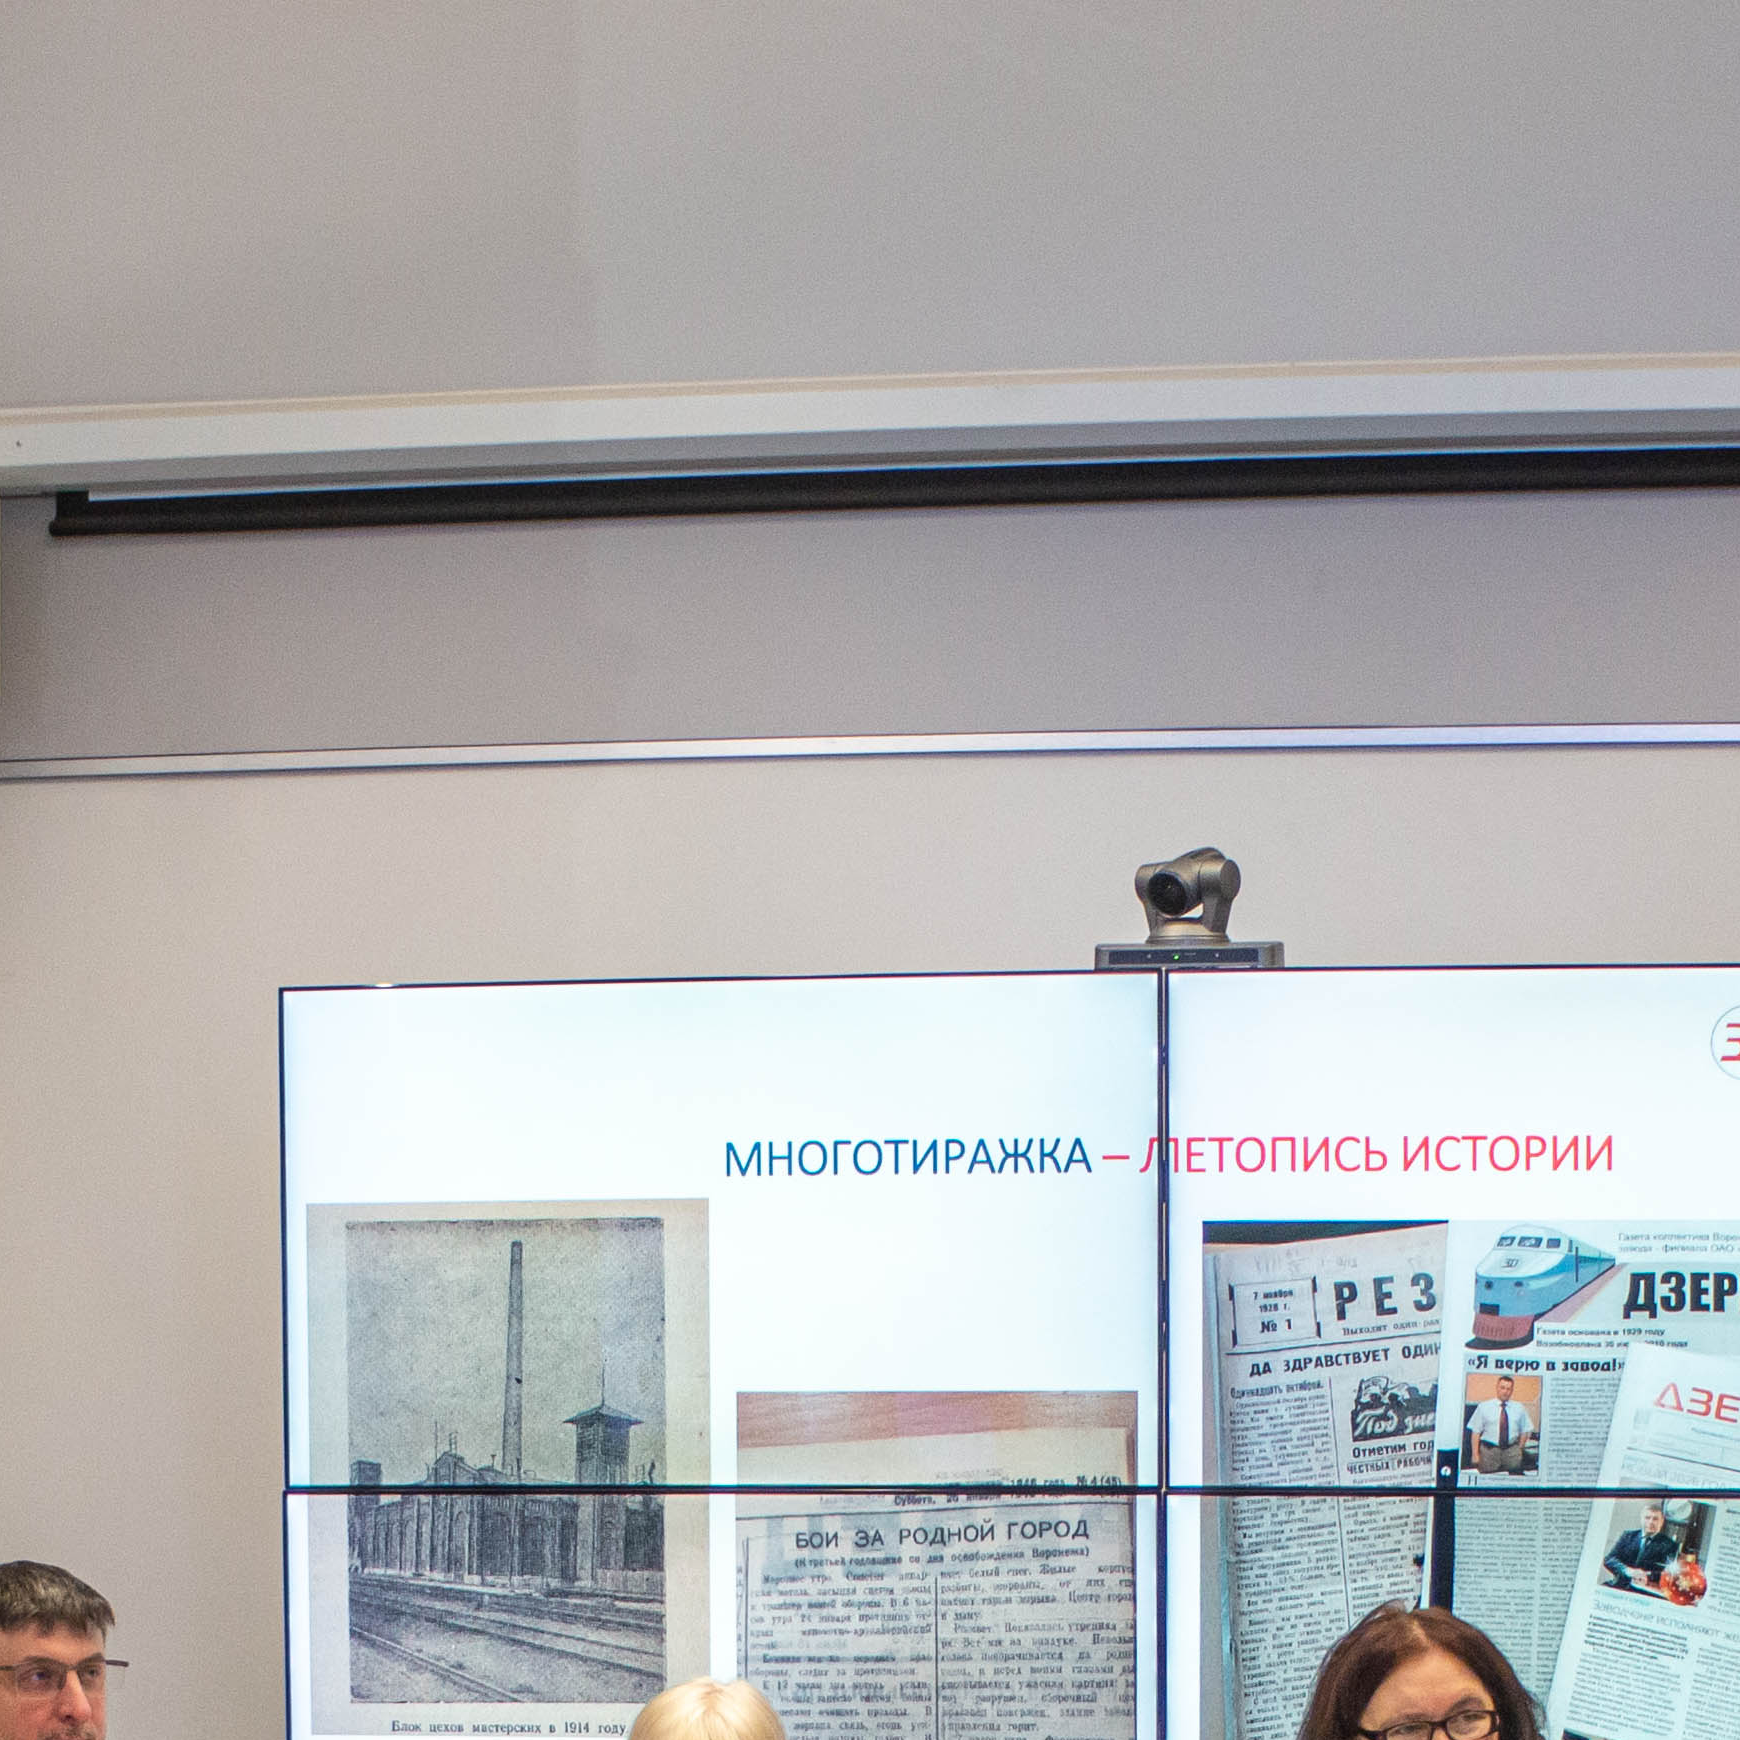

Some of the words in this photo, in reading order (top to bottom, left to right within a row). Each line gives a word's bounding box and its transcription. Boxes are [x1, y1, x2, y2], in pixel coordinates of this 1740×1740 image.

[724, 1137, 1093, 1177] МНОГОТИРАЖКА
[1139, 1135, 1388, 1174] ЛЕТОПИСЬ
[1401, 1134, 1616, 1174] ИСТОРИИ
[1283, 1347, 1391, 1374] ЗДРАВСТВУЕТ
[1495, 1358, 1541, 1374] верю
[1352, 1442, 1408, 1460] Отметим
[795, 1530, 840, 1550] БОИ
[854, 1528, 885, 1548] ЗА
[898, 1518, 996, 1548] РОДНОЙ
[1007, 1519, 1090, 1541] ГОРОД
[391, 1719, 422, 1734] Блок
[429, 1721, 465, 1736] цехов
[563, 1720, 591, 1735] 1914
